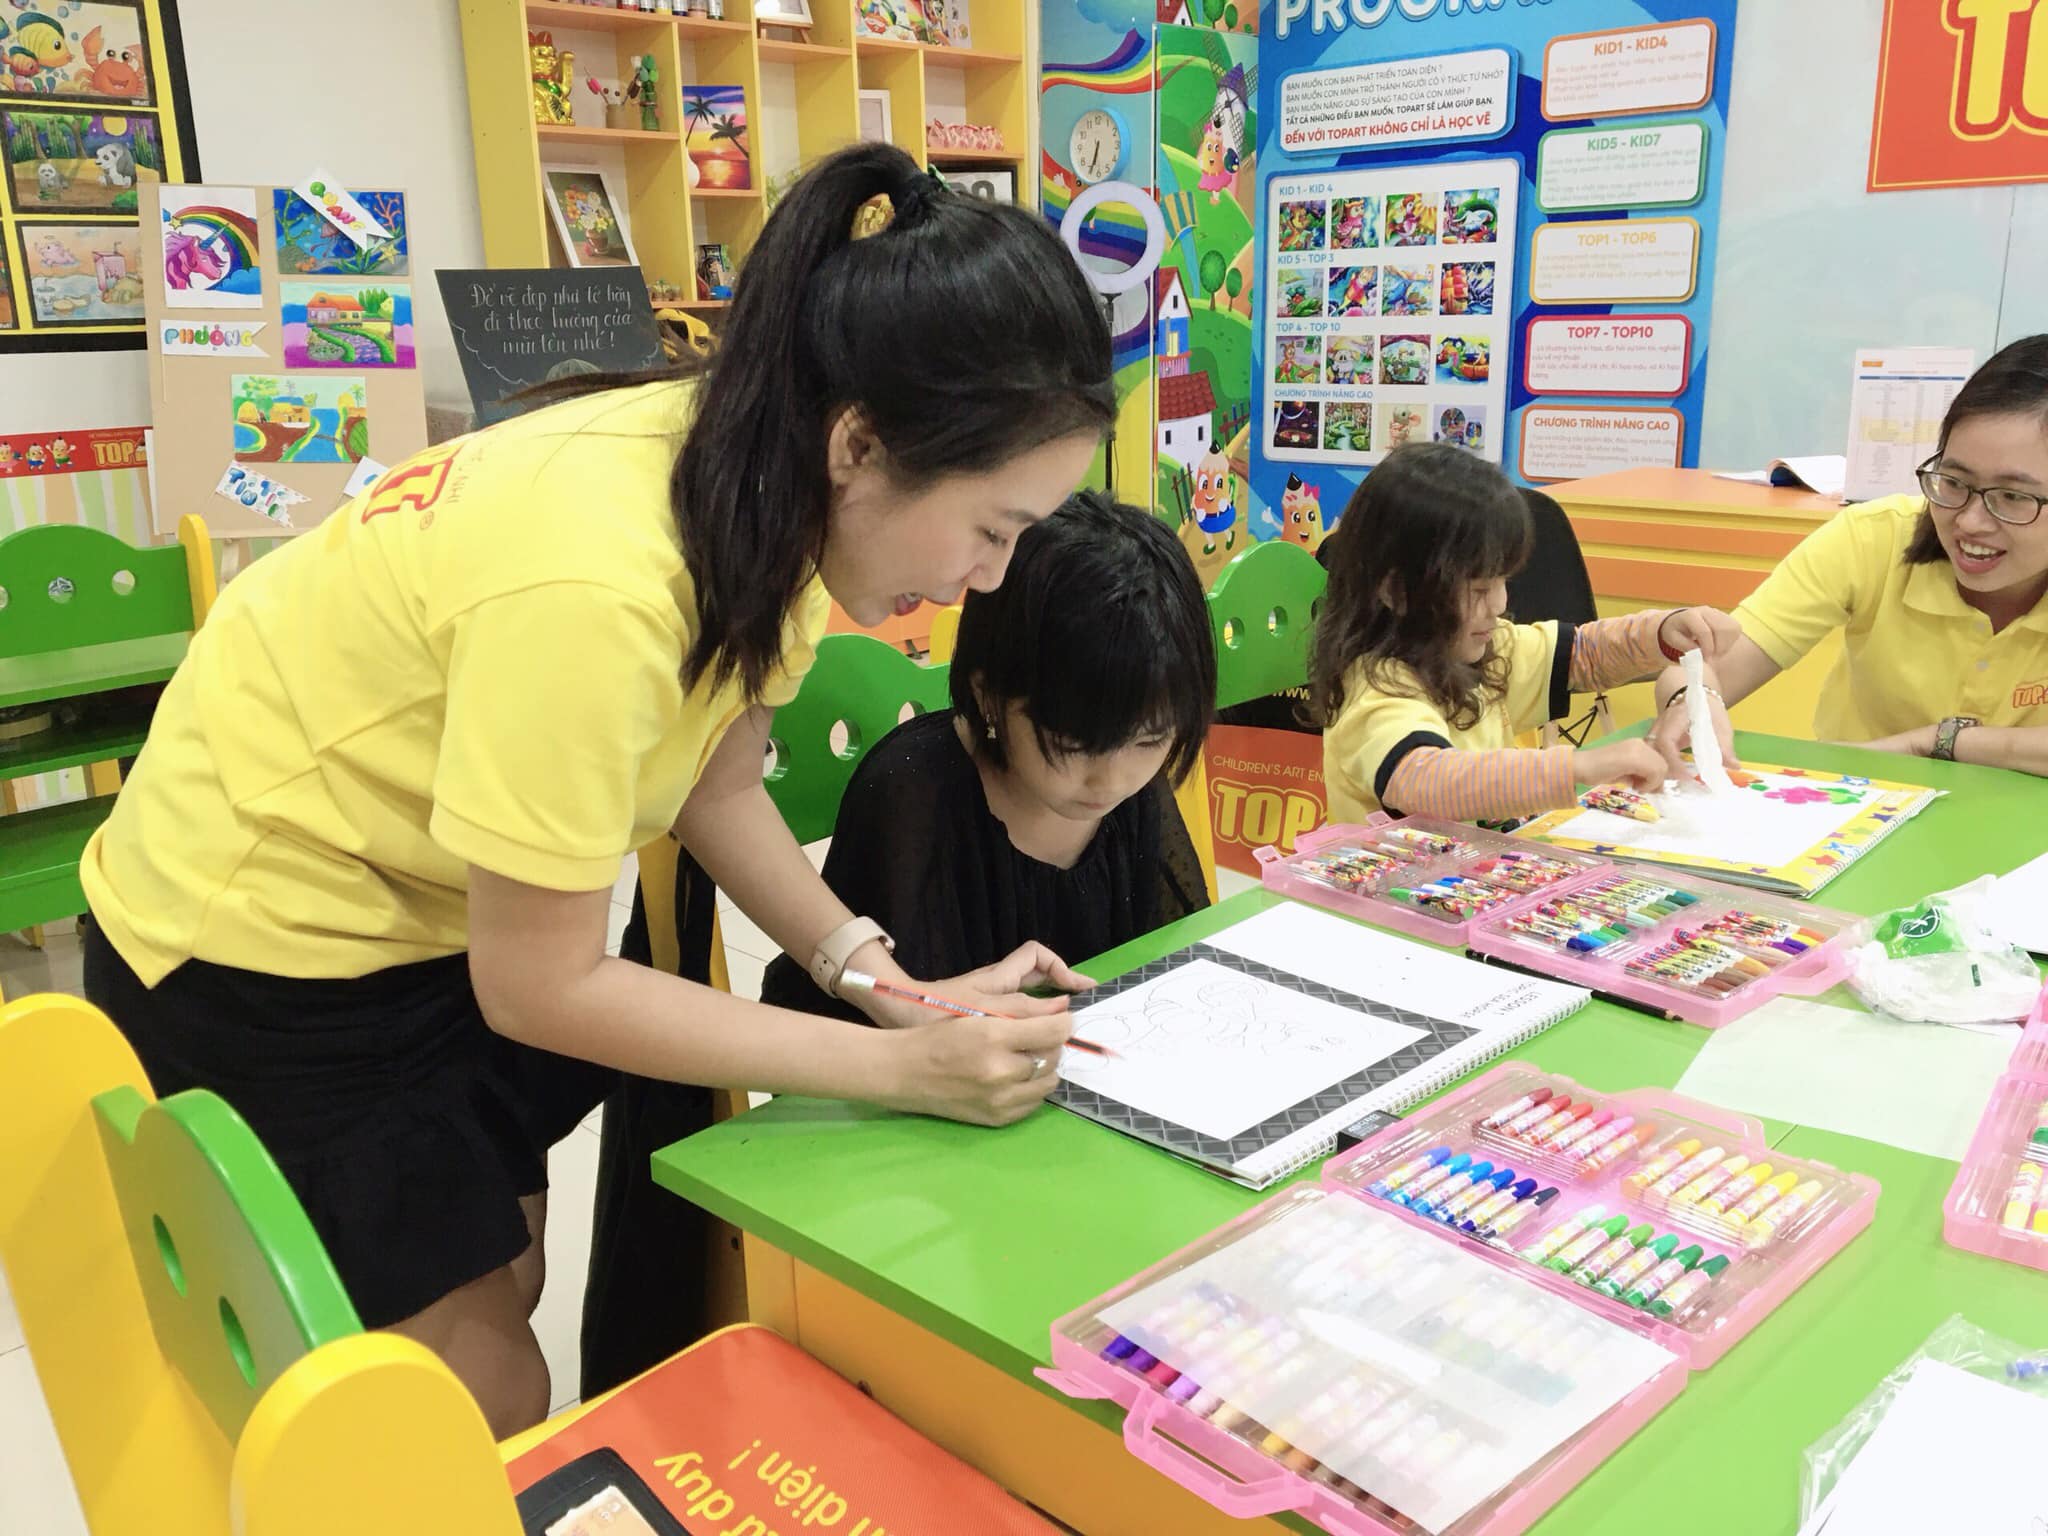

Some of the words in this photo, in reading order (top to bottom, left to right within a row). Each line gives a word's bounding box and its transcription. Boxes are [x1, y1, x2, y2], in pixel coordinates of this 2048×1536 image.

[1594, 42, 1623, 56] KID1
[1636, 36, 1668, 51] KID4
[1324, 78, 1339, 86] CON
[1324, 89, 1339, 98] CON
[1345, 98, 1359, 108] CAO
[1426, 89, 1442, 99] CON
[1310, 111, 1335, 123] NHỮNG
[1397, 104, 1425, 114] TOPART
[1426, 100, 1435, 111] SẼ
[1437, 98, 1453, 110] LÀM
[1455, 97, 1474, 108] GIÚP
[1087, 120, 1092, 129] 11
[1095, 115, 1102, 125] 12
[1106, 119, 1110, 127] 1
[1112, 127, 1118, 137] 2
[1285, 129, 1305, 144] ĐẾN
[1307, 127, 1326, 142] VỚI
[1327, 126, 1367, 139] TOPART
[1369, 121, 1408, 136] KHÔNG
[1411, 115, 1430, 131] CHỈ
[1432, 115, 1446, 130] LÀ
[1449, 115, 1473, 130] HỌC
[1476, 111, 1491, 126] VẼ
[1080, 131, 1087, 140] 10
[1114, 140, 1120, 150] 3
[1587, 137, 1618, 151] KID5
[1630, 134, 1661, 148] KID7
[1096, 169, 1101, 178] 6
[1105, 164, 1110, 173] 5
[1279, 186, 1295, 195] KID
[1309, 184, 1325, 193] KID
[1327, 184, 1333, 192] 4
[1577, 233, 1609, 247] TOP1
[1622, 231, 1657, 245] TOP6
[1277, 255, 1293, 265] KID
[1295, 254, 1301, 264] 5
[1308, 254, 1327, 263] TOP
[1328, 254, 1334, 262] 3
[1277, 323, 1294, 332] TOP
[1296, 323, 1302, 331] 4
[1309, 323, 1328, 332] TOP
[1330, 322, 1341, 331] 10
[1567, 326, 1600, 339] TOP7
[1611, 326, 1653, 339] TOP10
[1356, 391, 1373, 399] CAO
[1533, 416, 1577, 428] CHƯƠNG
[1580, 416, 1611, 429] TRÌNH
[1613, 417, 1644, 430] NÂNG
[1647, 420, 1670, 431] CAO
[1212, 754, 1281, 776] CHILDREN'S
[1283, 765, 1305, 780] ART
[653, 1452, 735, 1521] duy
[756, 1451, 848, 1527] diện
